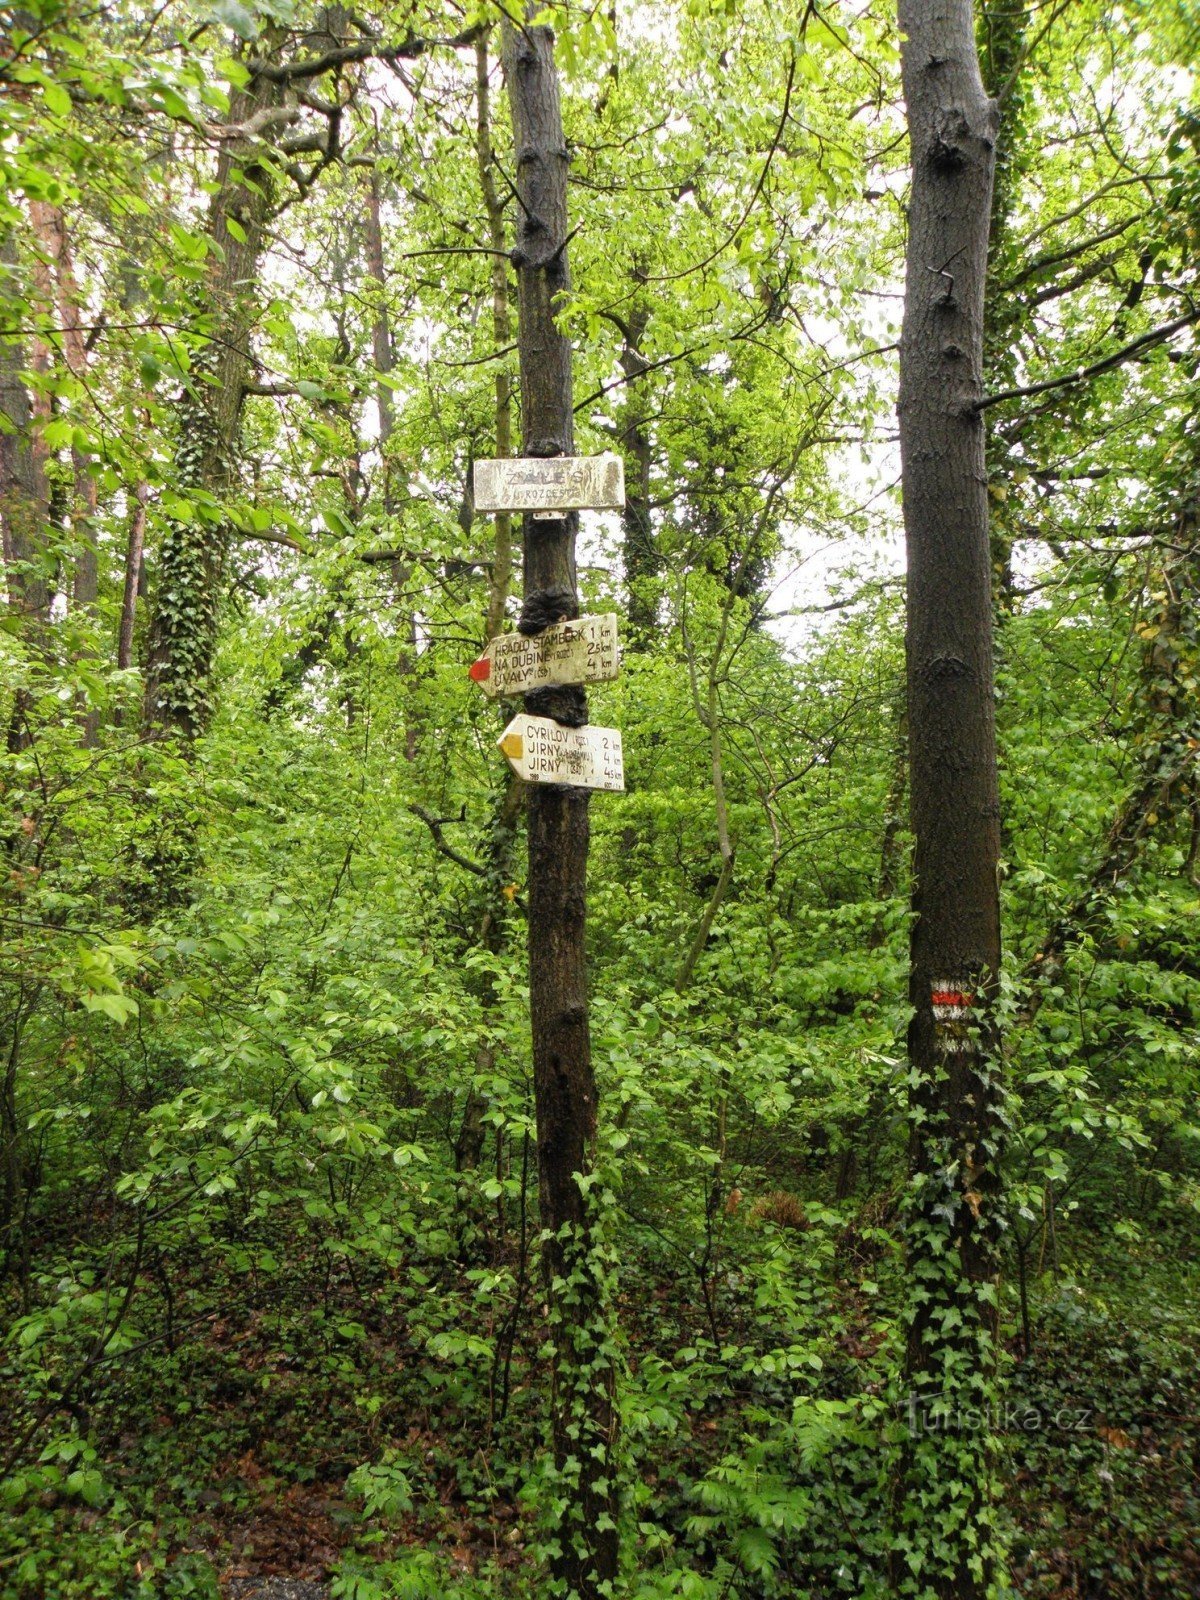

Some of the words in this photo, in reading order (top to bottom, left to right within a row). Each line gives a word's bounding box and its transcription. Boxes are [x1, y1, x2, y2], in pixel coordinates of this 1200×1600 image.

[590, 627, 595, 639] 1
[600, 626, 611, 638] km
[494, 659, 508, 672] NA
[587, 658, 595, 670] 4
[601, 658, 612, 669] km
[527, 725, 569, 743] CYRILOV
[602, 737, 609, 749] 2
[528, 742, 560, 756] JIRNY
[603, 752, 610, 764] 4
[528, 758, 561, 773] JIRNY
